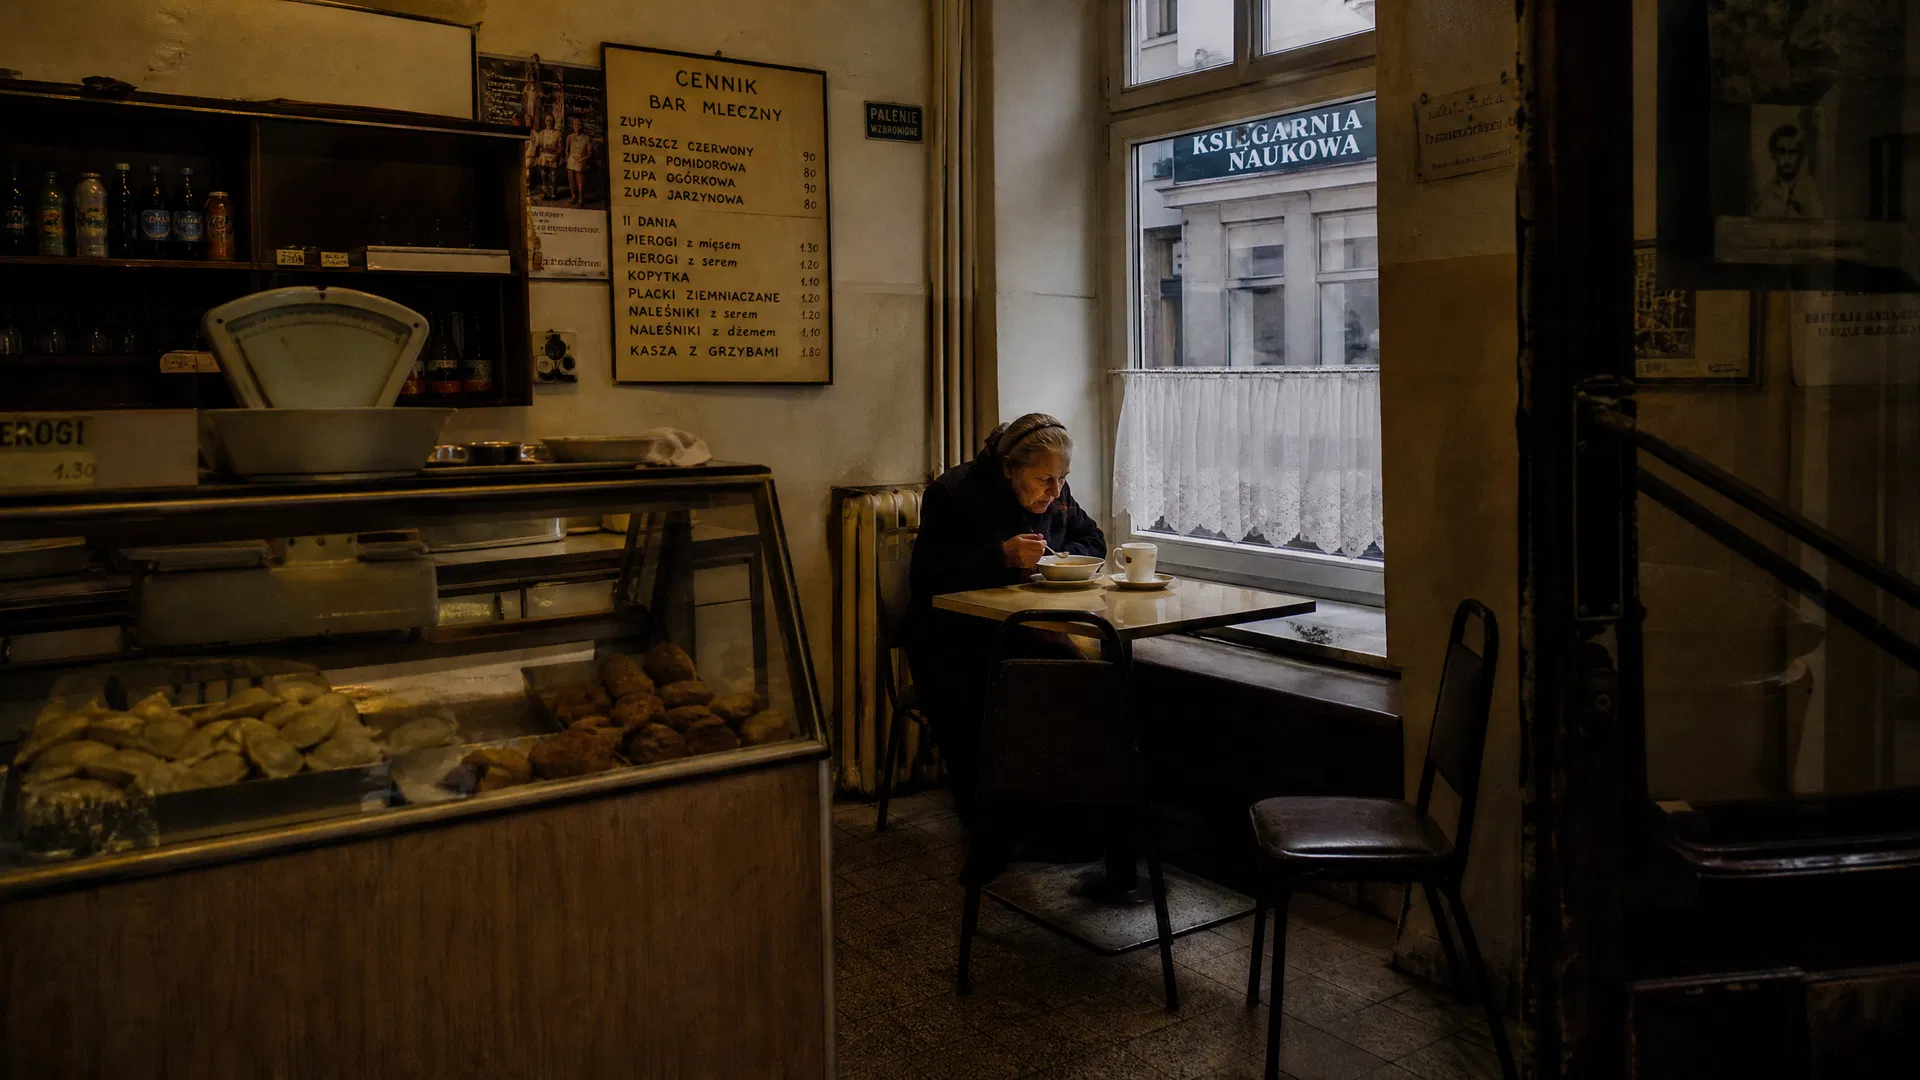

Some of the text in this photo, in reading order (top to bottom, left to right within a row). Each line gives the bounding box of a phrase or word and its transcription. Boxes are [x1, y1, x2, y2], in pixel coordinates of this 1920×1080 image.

[675, 70, 758, 95] CENNIK
[649, 95, 782, 121] BAR MLECZNY
[870, 107, 918, 124] PALENIE
[620, 116, 653, 129] ZUPY
[1192, 109, 1362, 155] KSIĘGARNIA
[623, 135, 816, 162] BARSZCZ CZERWONY 90
[1228, 134, 1360, 172] NAUKOWA
[623, 153, 816, 177] ZUPA POMIDOROWA 80
[624, 170, 816, 193] ZUPA OGÓRKOWA 90
[624, 187, 817, 209] ZUPA JARZYNOWA 80
[638, 216, 677, 228] DANIA
[626, 234, 819, 252] PIEROGI z mięsem 1.30
[627, 252, 819, 269] PIEROGI z serem 1.20
[628, 270, 820, 287] KOPYTKA 1.10
[629, 288, 820, 303] PLACKI ZIEMNIACZANE 1.20
[629, 304, 820, 320] NALEŚNIKI z serem 1.20
[630, 322, 820, 337] NALEŚNIKI z dżemem 1.10
[631, 345, 820, 358] KASZA Z GRZYBAMI 1.80
[53, 462, 96, 479] 1.30
